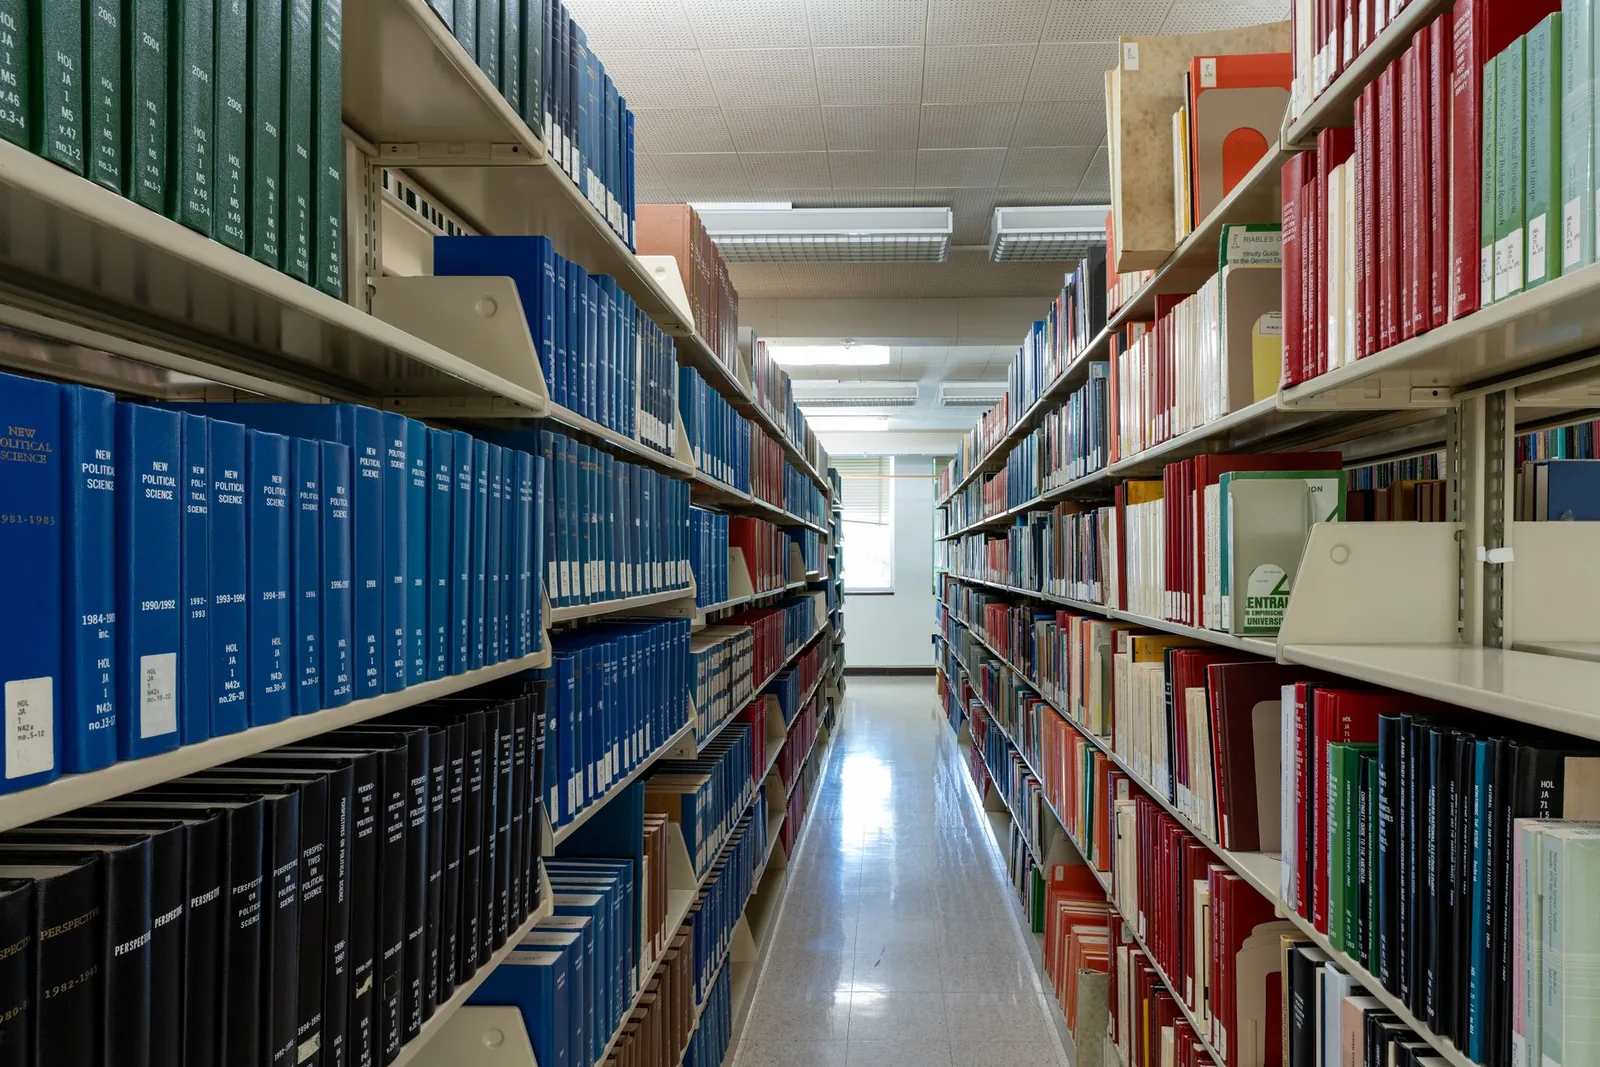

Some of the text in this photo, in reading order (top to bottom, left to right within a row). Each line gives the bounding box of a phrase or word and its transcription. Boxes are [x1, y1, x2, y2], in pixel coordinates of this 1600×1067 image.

[98, 6, 117, 28] 2003
[2, 32, 13, 48] JA
[142, 32, 159, 53] 2004
[6, 52, 11, 65] 1
[57, 52, 74, 70] HOL
[1, 69, 17, 87] M5
[61, 72, 72, 86] JA
[192, 65, 208, 83] 2004
[101, 77, 114, 92] HOL
[65, 91, 69, 102] 1
[104, 95, 112, 107] JA
[146, 99, 157, 113] HOL
[227, 96, 242, 113] 2005
[61, 106, 74, 122] M5
[59, 125, 76, 140] v.47
[103, 128, 113, 141] M5
[193, 126, 207, 142] HOL
[55, 141, 81, 160] no.1-2
[101, 145, 115, 157] v.47
[197, 143, 205, 155] JA
[228, 153, 241, 168] HOL
[98, 158, 118, 176] no.3-4
[195, 172, 206, 185] M5
[231, 170, 239, 181] JA
[1484, 170, 1492, 204] Mobility
[1529, 170, 1537, 202] Europe
[189, 201, 211, 217] no.3-4
[230, 197, 240, 209] M5
[1498, 190, 1506, 226] Research
[227, 211, 241, 224] v.49
[225, 225, 244, 239] no.1-2
[1262, 249, 1279, 257] Guide
[8, 426, 36, 438] NEW
[0, 438, 52, 452] OLITICAL
[0, 450, 47, 464] SCIENCE
[95, 449, 111, 460] NEW
[366, 447, 376, 456] NEW
[152, 461, 168, 472] NEW
[192, 466, 204, 474] NEW
[142, 474, 176, 487] POLITICAL
[224, 470, 238, 479] NEW
[271, 475, 283, 484] NEW
[87, 478, 114, 490] SCIENCE
[190, 479, 206, 488] POLI-
[215, 481, 245, 492] POLITICAL
[145, 488, 174, 500] SCIENCE
[191, 492, 206, 501] TICAL
[218, 494, 243, 505] SCIENCE
[141, 600, 176, 611] 1990/1992
[190, 597, 207, 606] 1992-
[1246, 596, 1289, 609] ENTRA
[192, 610, 206, 619] 1993
[98, 628, 110, 639] inc.
[271, 637, 281, 646] HOL
[225, 643, 238, 653] HOL
[97, 658, 110, 669] HOL
[228, 656, 236, 665] JA
[101, 673, 109, 684] JA
[225, 680, 241, 690] N42x
[17, 700, 29, 708] HOL
[96, 702, 112, 714] N42x
[17, 708, 26, 716] JA
[17, 724, 34, 732] N42x
[17, 730, 45, 741] no.5-12
[1540, 780, 1554, 788] HOL
[1540, 790, 1549, 798] JA
[1540, 801, 1548, 809] 71
[303, 842, 325, 858] PERSPEC-
[307, 854, 320, 867] TIVES
[310, 866, 317, 876] ON
[302, 874, 324, 891] POLITICAL
[248, 892, 256, 902] ON
[303, 885, 322, 901] SCIENCE
[154, 904, 183, 929] PERSPECTIVE
[114, 929, 152, 957] PERSPECTIVE
